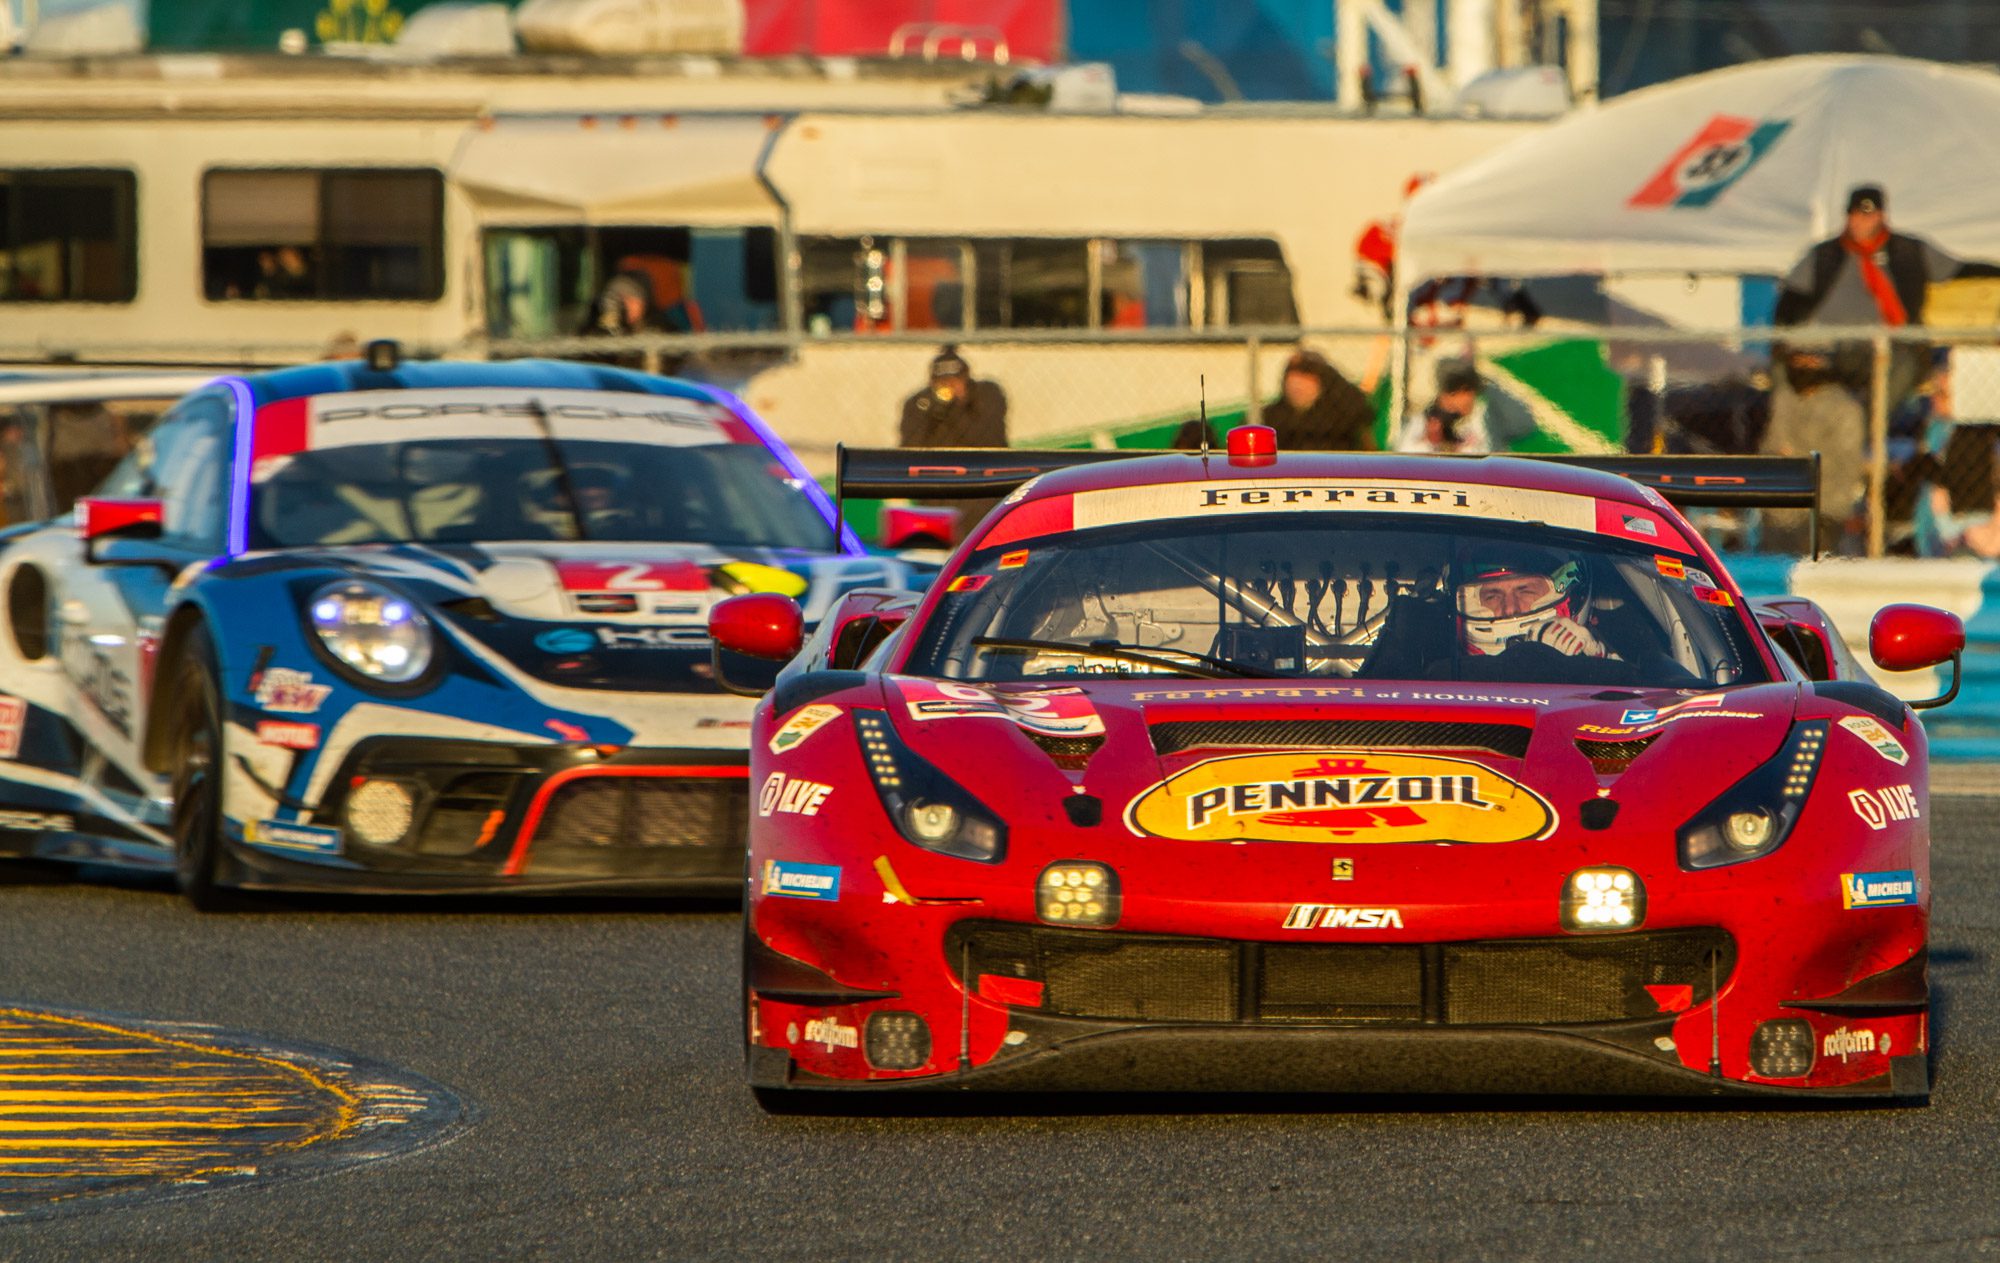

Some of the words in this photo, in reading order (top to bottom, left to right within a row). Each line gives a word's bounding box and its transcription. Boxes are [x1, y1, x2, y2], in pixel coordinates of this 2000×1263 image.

[318, 402, 722, 431] PORSCHE
[1200, 486, 1471, 507] Ferrari
[594, 561, 666, 590] 2
[1130, 686, 1366, 702] Ferrari
[1376, 691, 1401, 699] of
[1411, 692, 1551, 707] HOUSTON
[1186, 774, 1495, 831] PENNZOIL
[780, 872, 834, 891] MICHELIN
[1867, 880, 1913, 898] MICHELIN
[1319, 907, 1405, 929] IMSA
[1823, 1026, 1876, 1064] rotiform
